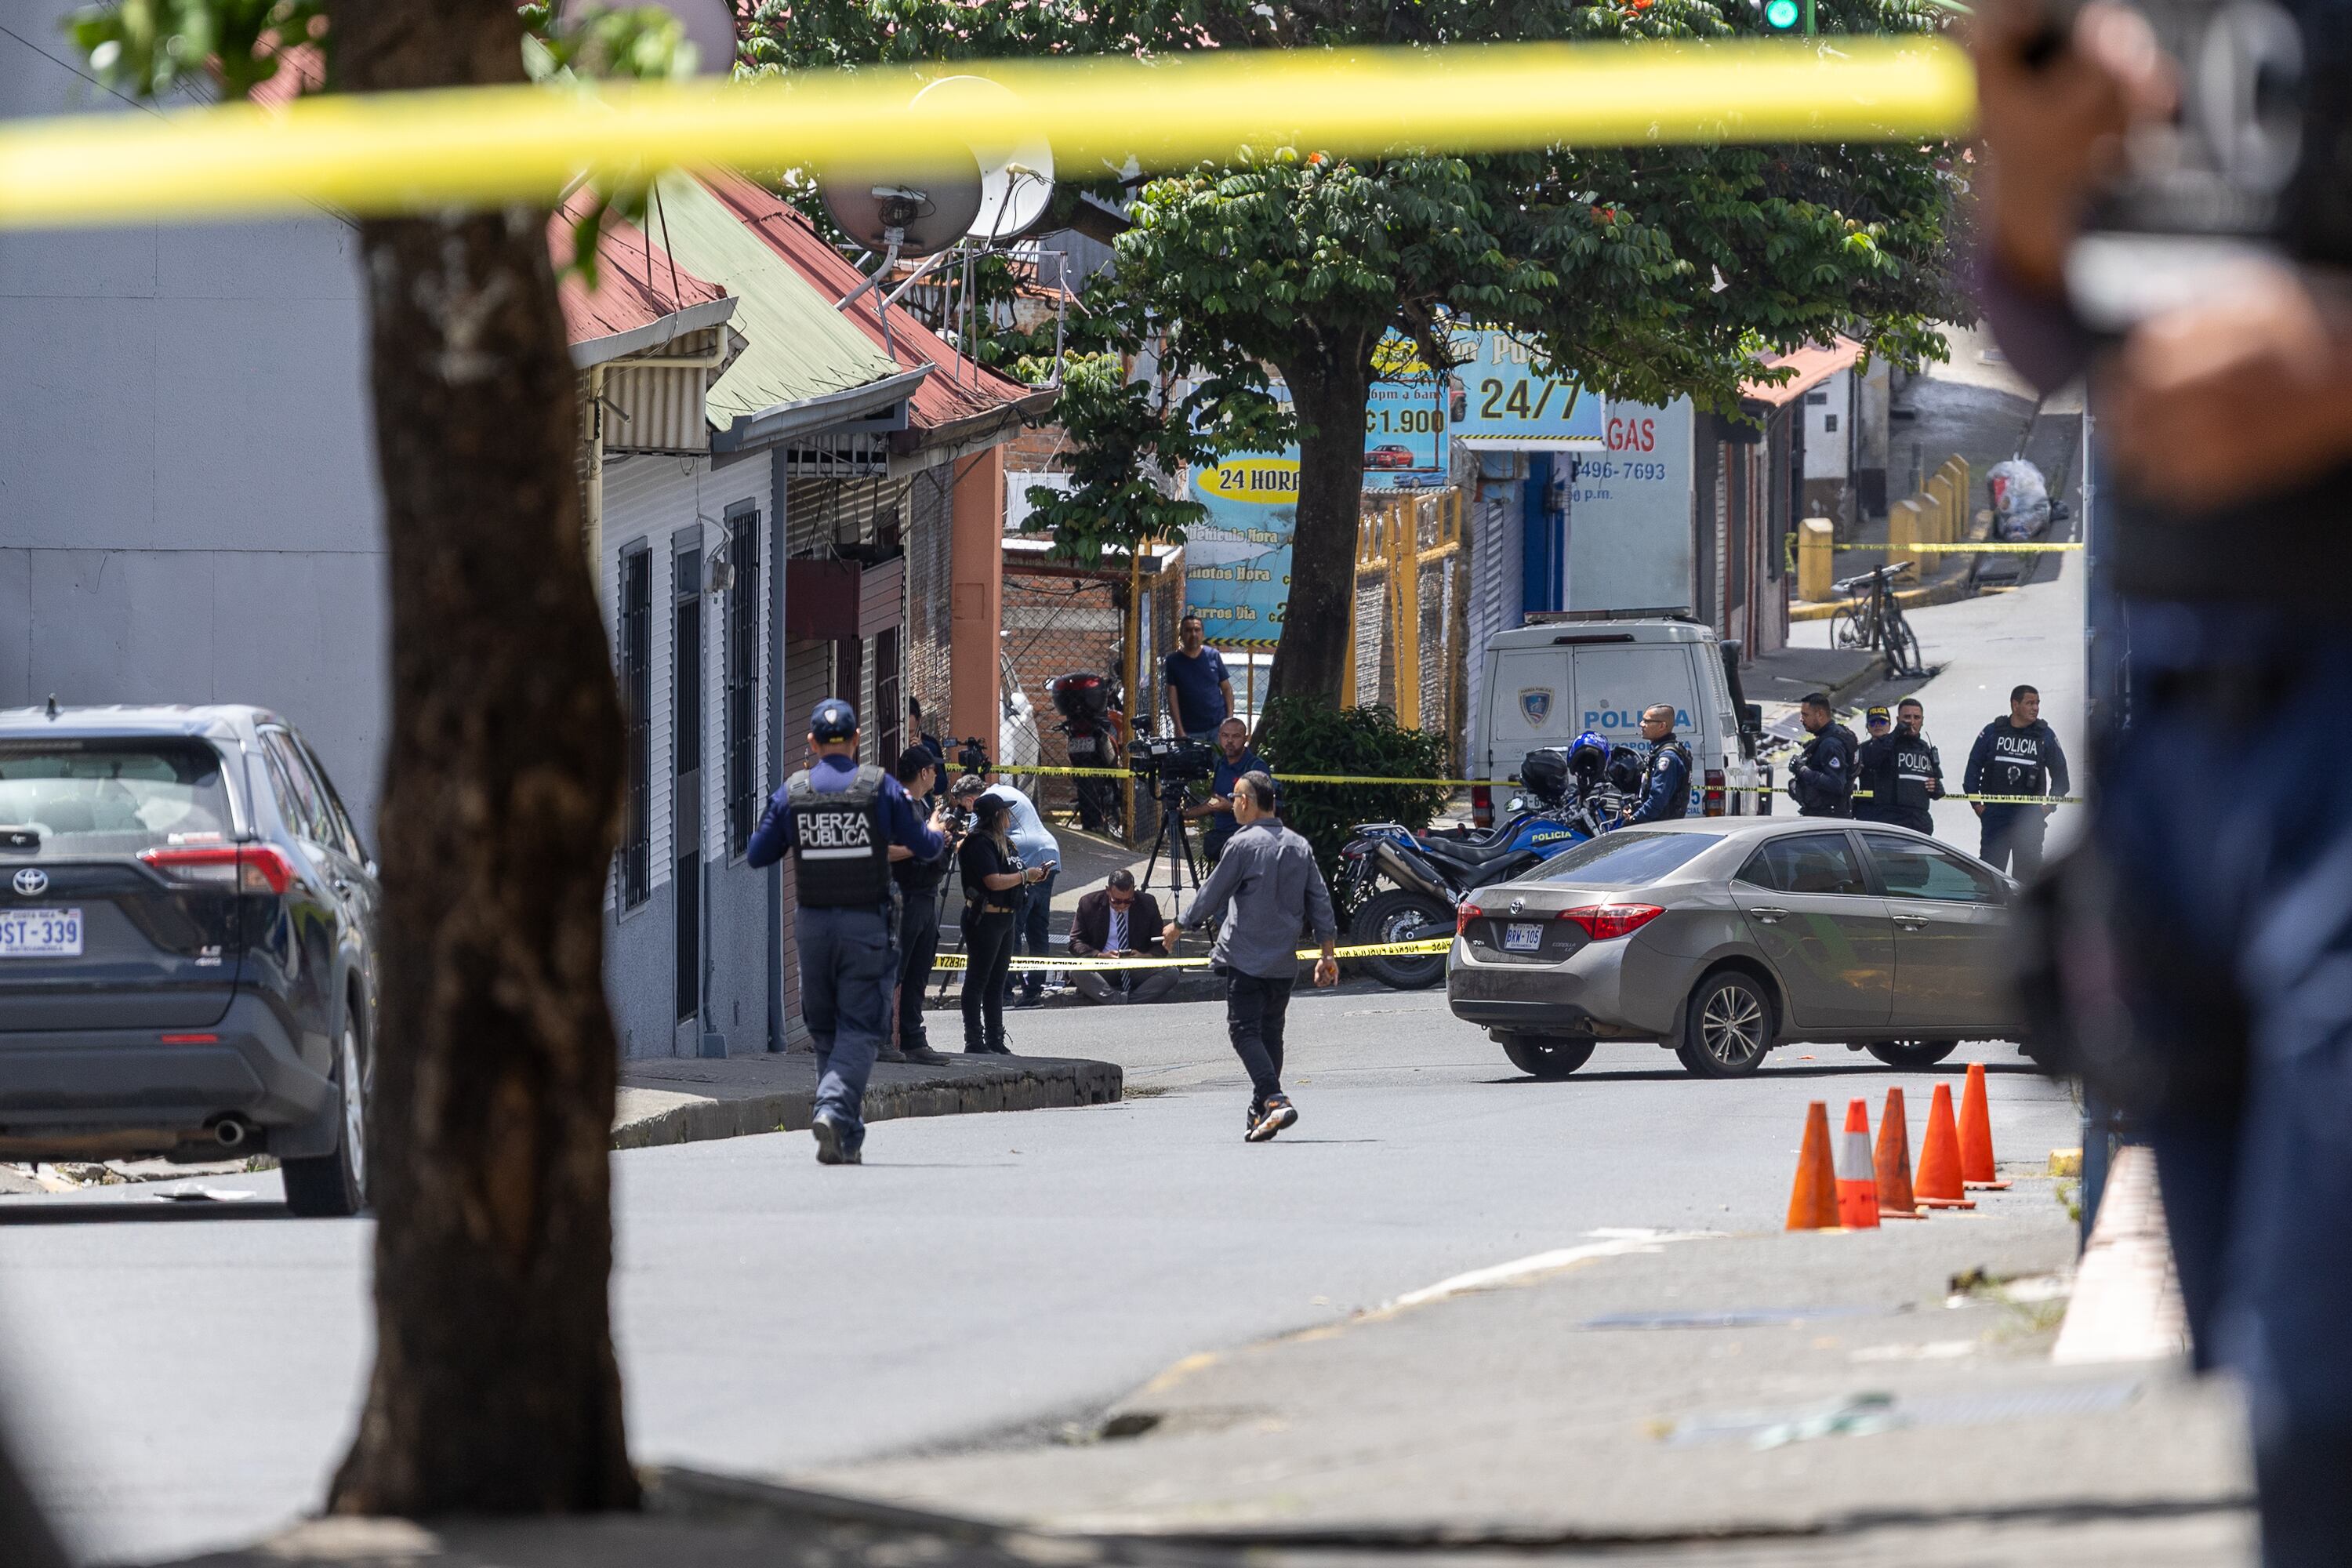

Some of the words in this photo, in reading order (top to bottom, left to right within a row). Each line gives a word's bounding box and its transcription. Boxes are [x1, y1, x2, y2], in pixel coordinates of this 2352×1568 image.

[1370, 389, 1397, 401] 6pm
[1402, 392, 1409, 401] a
[1480, 378, 1579, 419] 24/7
[1608, 418, 1654, 452] GAS
[1220, 469, 1244, 488] 24
[1585, 489, 1613, 502] p.m.
[1247, 528, 1278, 543] Hora
[1236, 566, 1271, 582] Hora
[1995, 736, 2038, 756] POLICIA
[797, 811, 870, 829] FUERZA
[1531, 831, 1572, 842] POLICIA
[0, 920, 77, 944] ST-339
